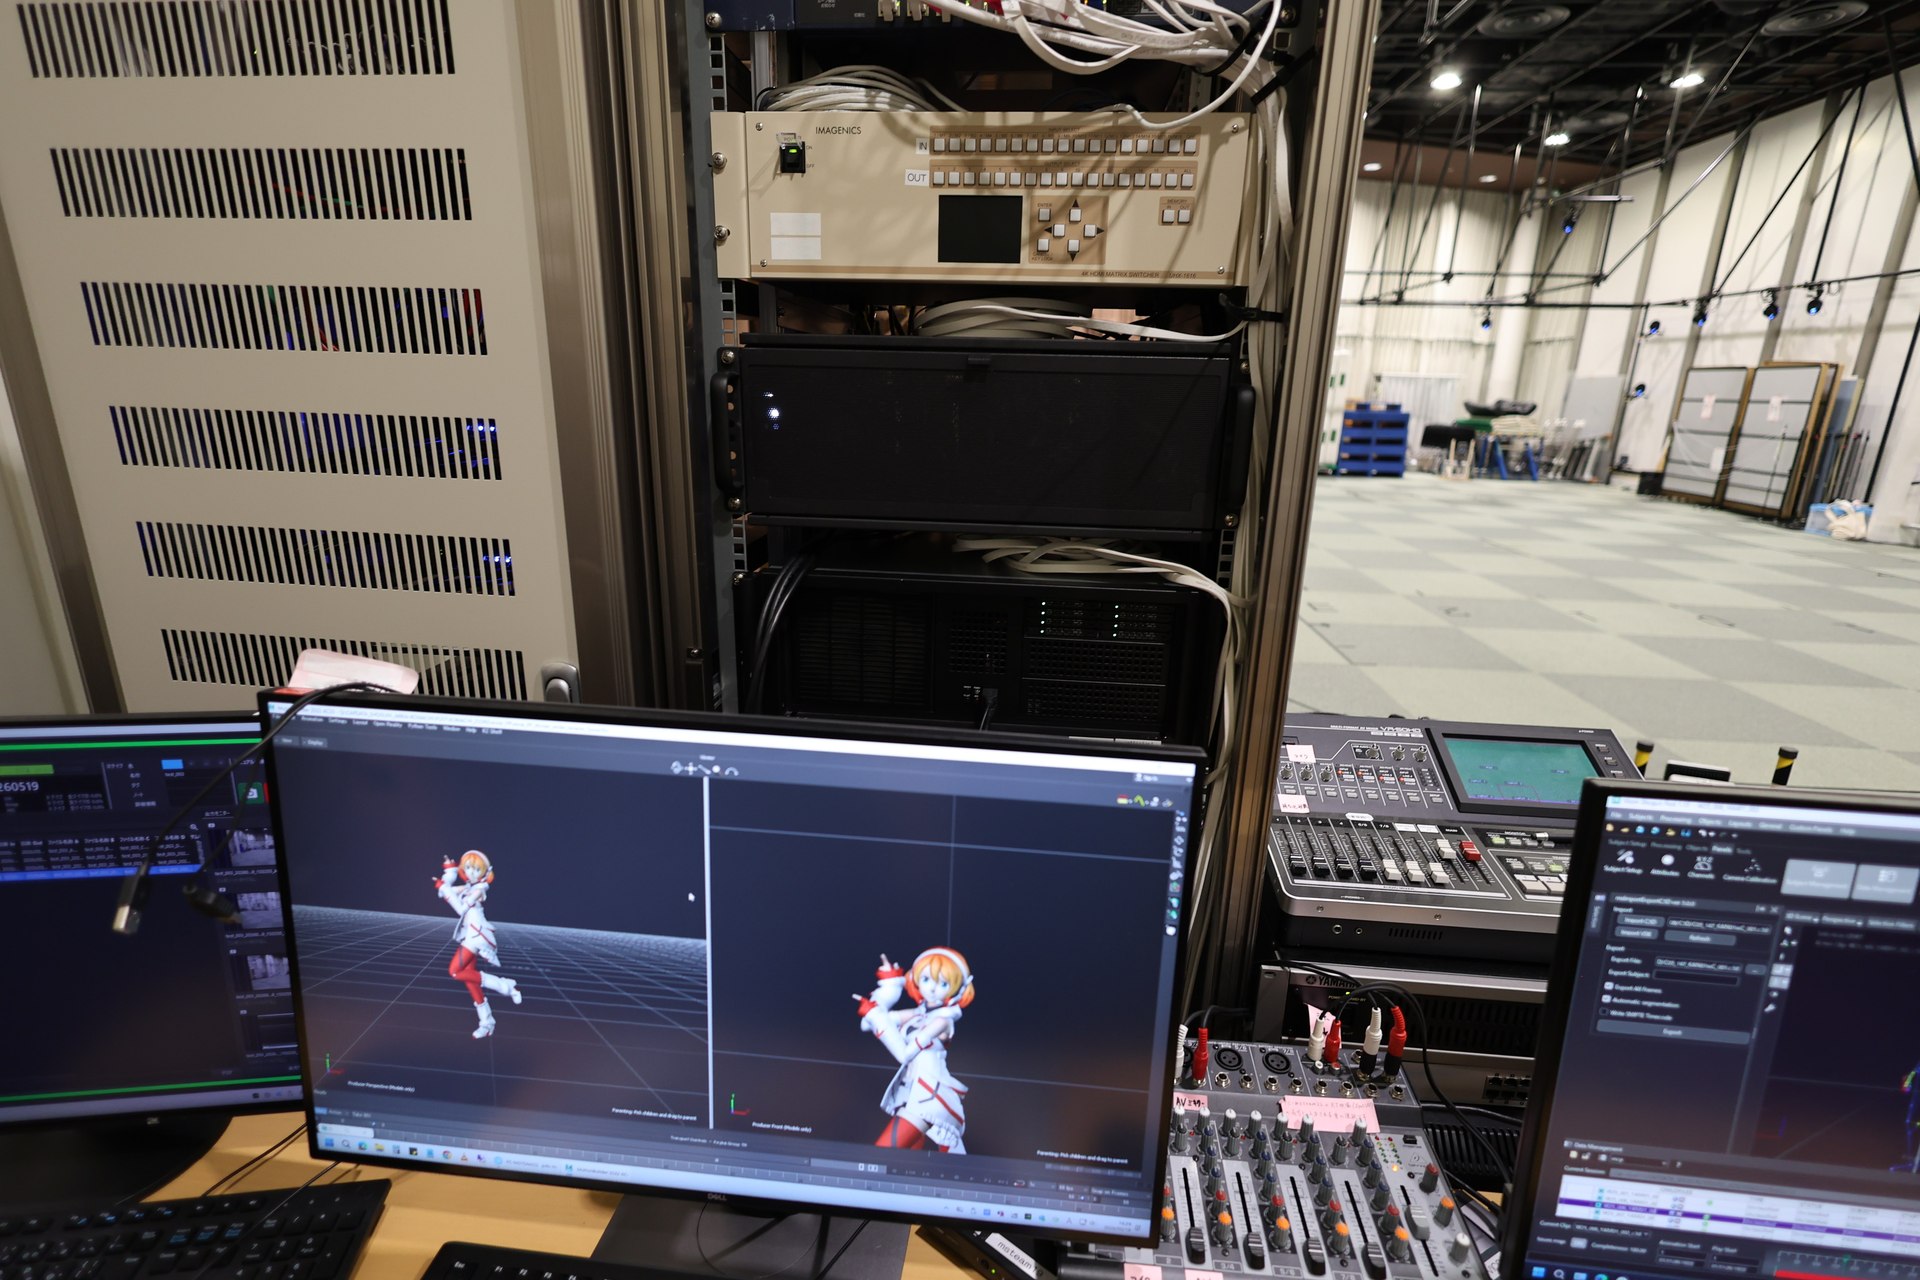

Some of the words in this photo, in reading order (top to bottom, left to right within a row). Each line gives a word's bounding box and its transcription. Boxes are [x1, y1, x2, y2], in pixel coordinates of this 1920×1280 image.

[815, 126, 862, 135] IMAGENICS
[919, 142, 928, 151] IN
[907, 173, 927, 182] OUT
[1659, 815, 1693, 825] Processing
[1603, 865, 1625, 873] Subject
[1625, 867, 1643, 875] Setup
[707, 1192, 728, 1201] DELL
[494, 1265, 504, 1273] F1
[1221, 1261, 1235, 1270] 3/4
[518, 1268, 528, 1276] F2
[543, 1271, 553, 1279] F3
[1280, 1267, 1296, 1276] 5/6
